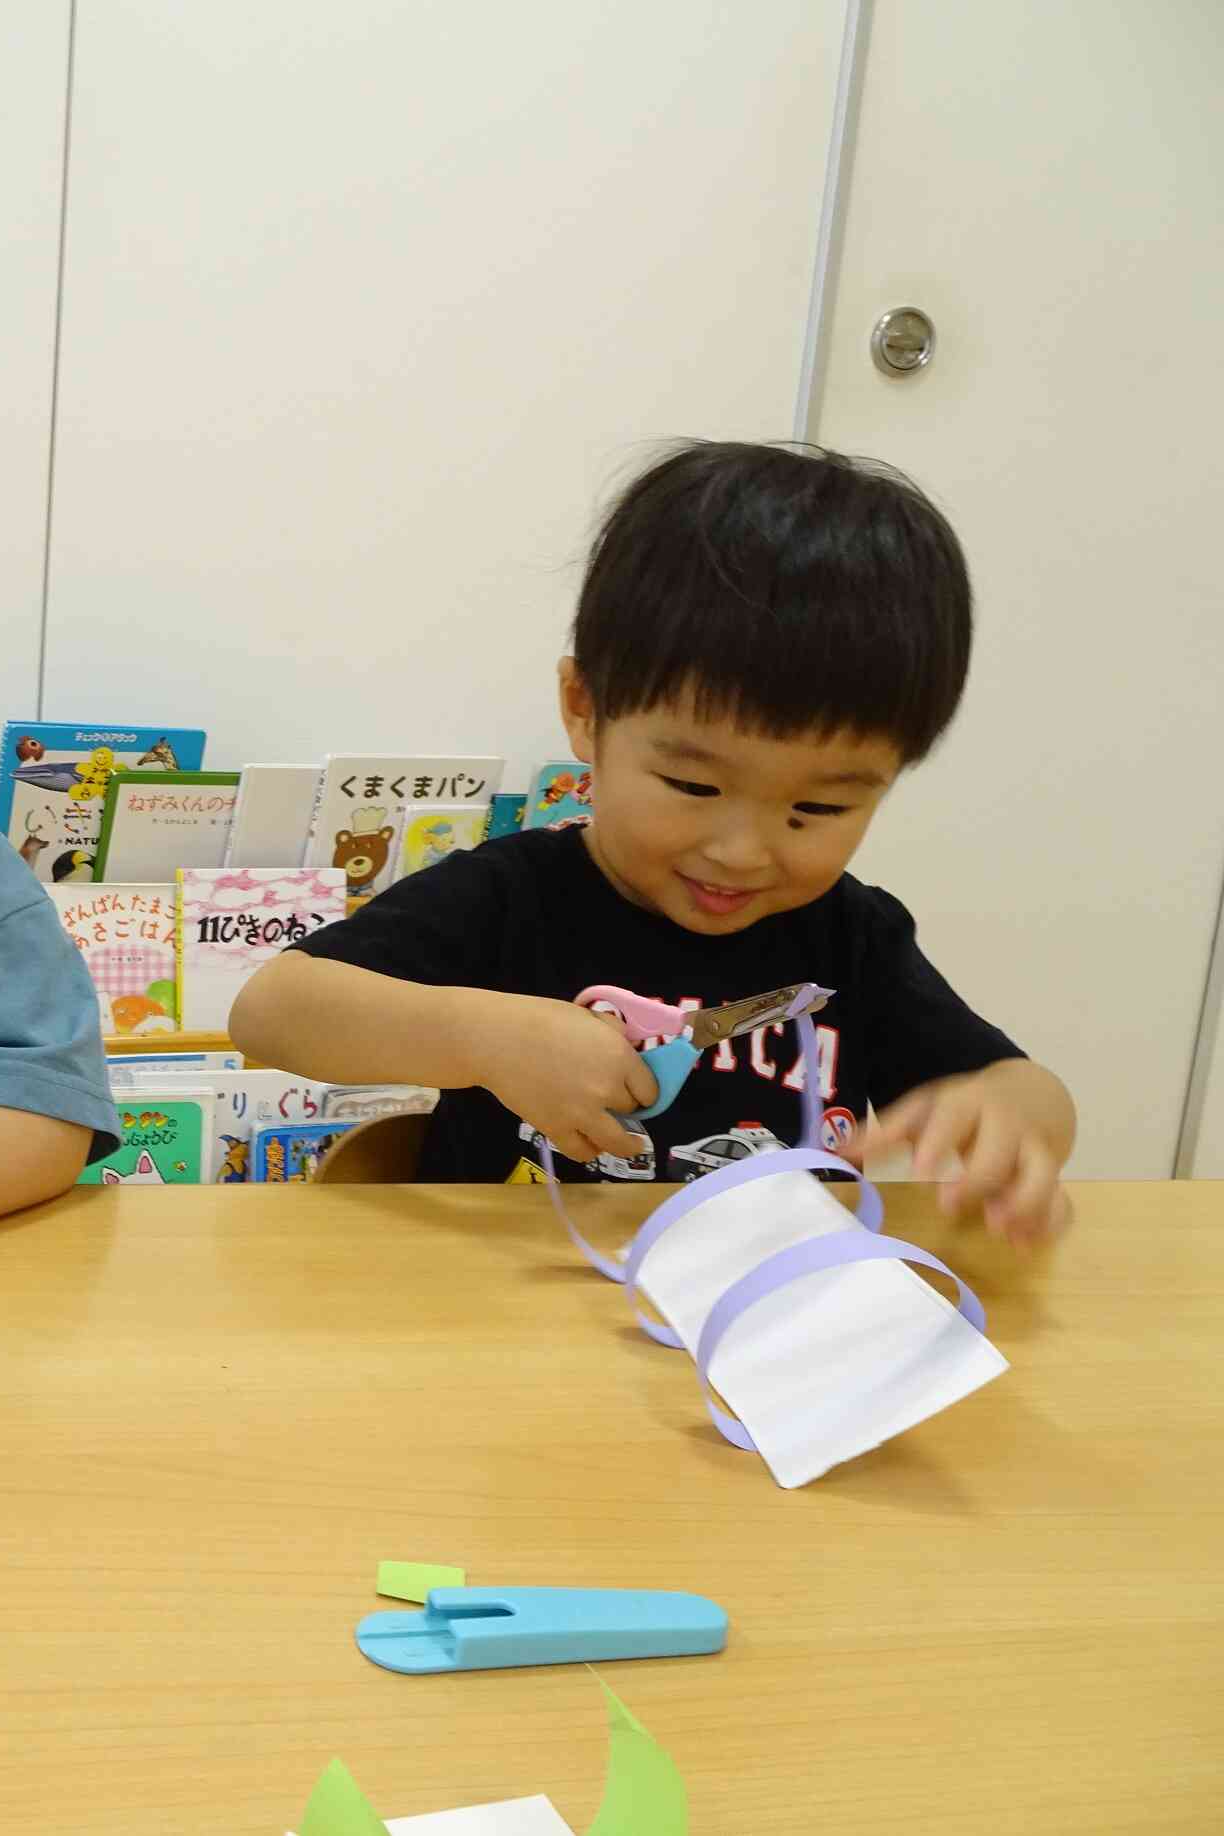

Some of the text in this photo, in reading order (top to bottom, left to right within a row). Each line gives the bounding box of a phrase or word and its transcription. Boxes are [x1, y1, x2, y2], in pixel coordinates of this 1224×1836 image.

[340, 773, 485, 798] くまくまパン
